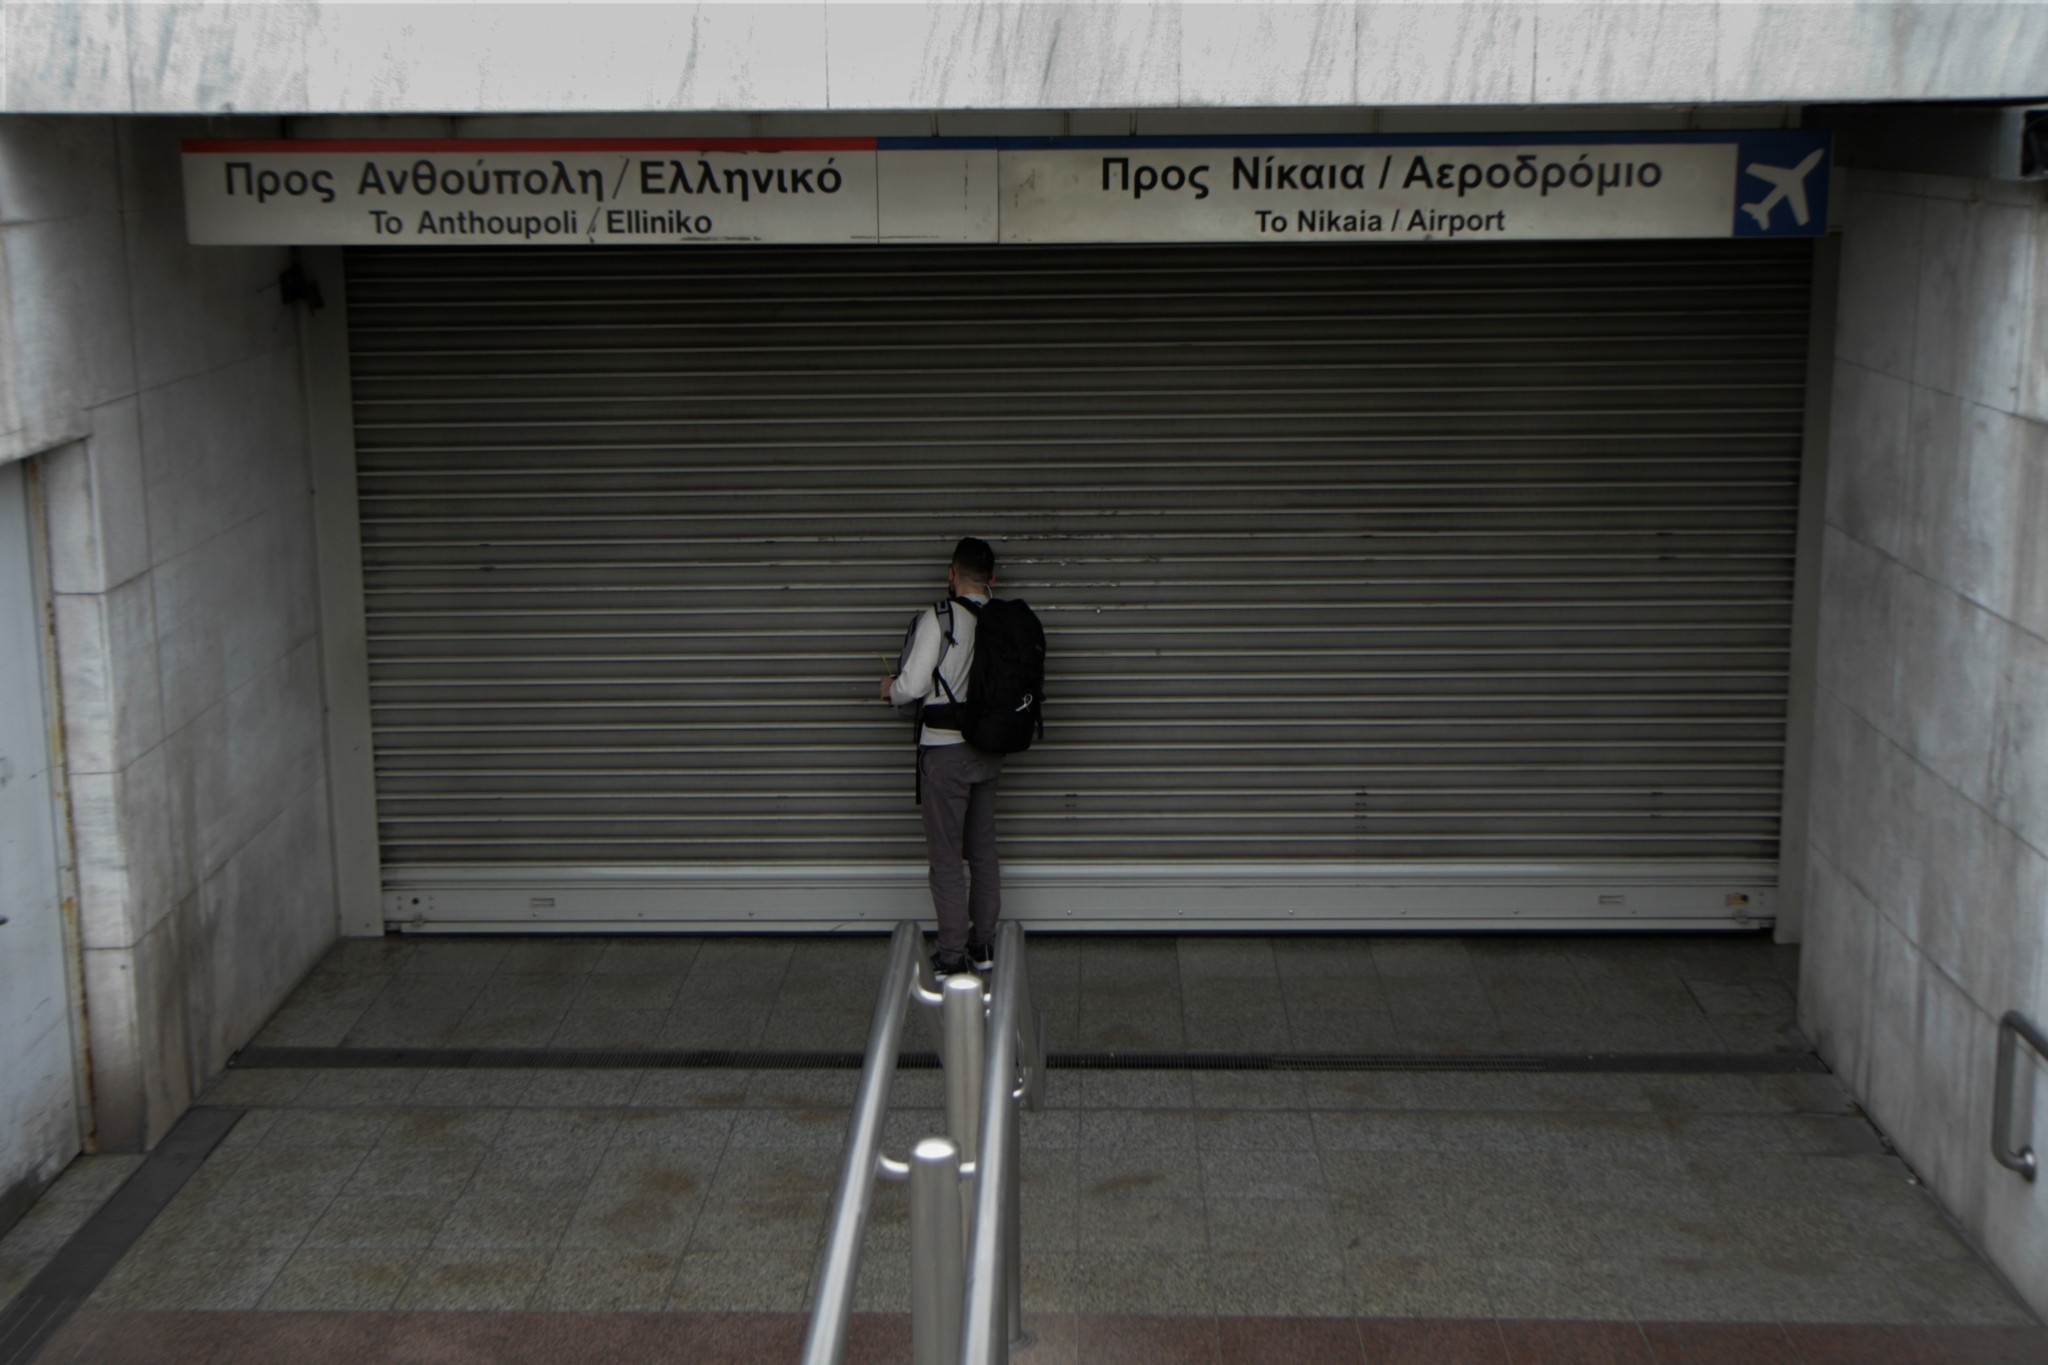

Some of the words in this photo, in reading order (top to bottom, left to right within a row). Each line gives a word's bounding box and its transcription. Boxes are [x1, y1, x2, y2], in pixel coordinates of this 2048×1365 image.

[223, 160, 336, 201] Προς
[357, 158, 604, 201] Ανθούπολη
[639, 157, 843, 201] Ελληνικό
[1101, 156, 1211, 199] Προς
[1232, 155, 1365, 190] Νίκαια
[1402, 153, 1662, 197] Αεροδρόμιο
[367, 209, 403, 234] To
[417, 209, 578, 239] Anthoupoli
[605, 208, 713, 234] Elliniko
[1254, 209, 1288, 233] To
[1297, 209, 1383, 232] Nikaia
[1406, 208, 1506, 236] Airport
